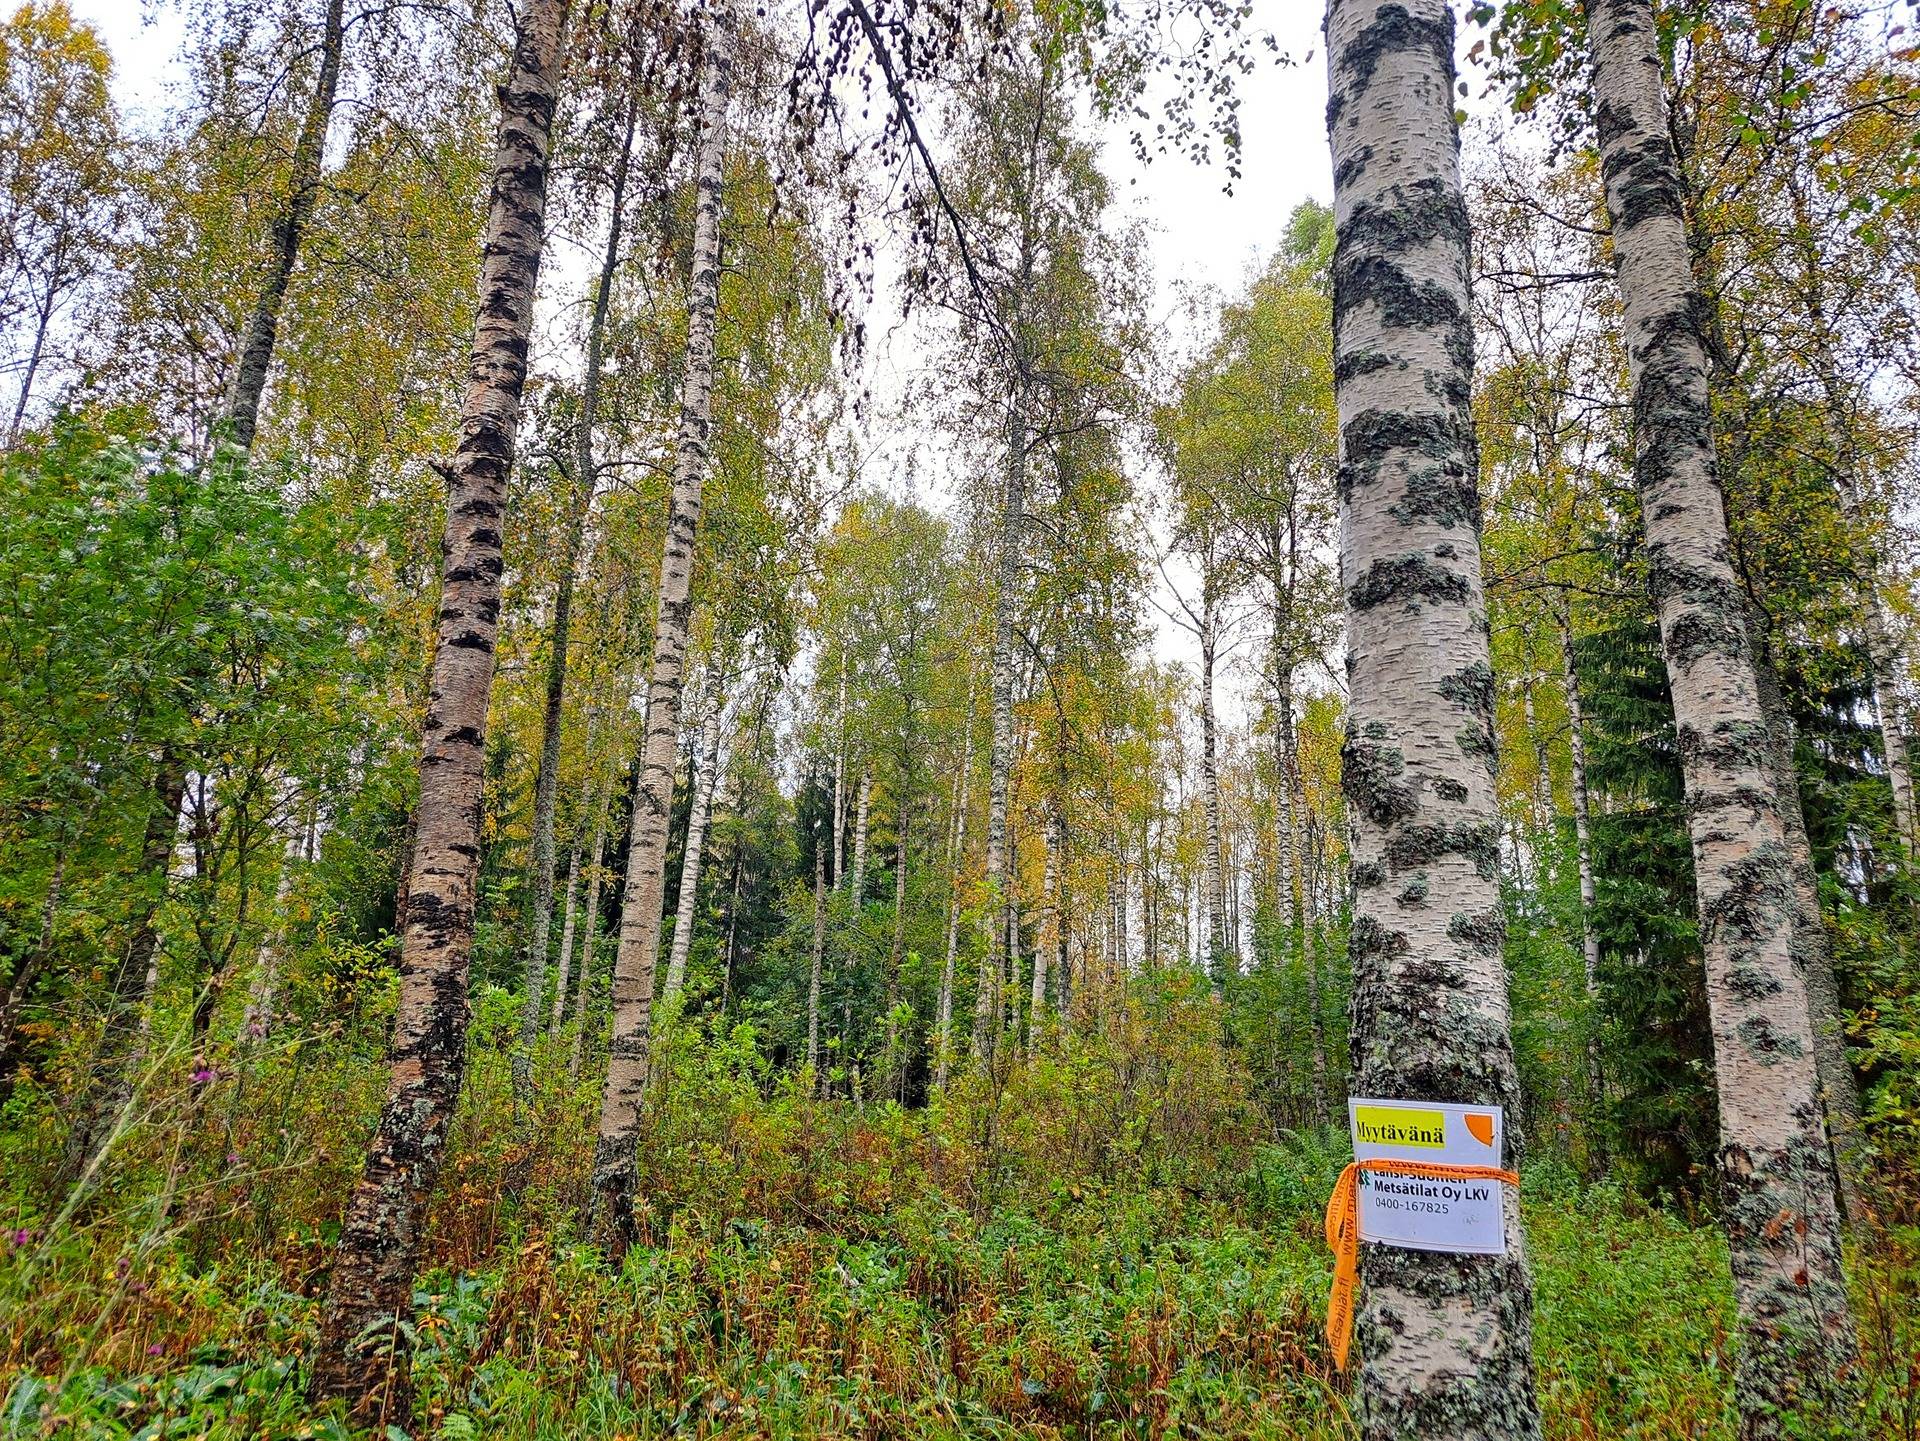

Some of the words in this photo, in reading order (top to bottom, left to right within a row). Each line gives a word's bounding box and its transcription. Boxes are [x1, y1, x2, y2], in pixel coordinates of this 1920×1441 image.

[1356, 1120, 1444, 1144] Myytävänä
[1374, 1180, 1438, 1198] Metsätilat
[1442, 1187, 1462, 1202] Oy
[1465, 1188, 1489, 1201] LKV
[1375, 1197, 1449, 1214] 0400-167825
